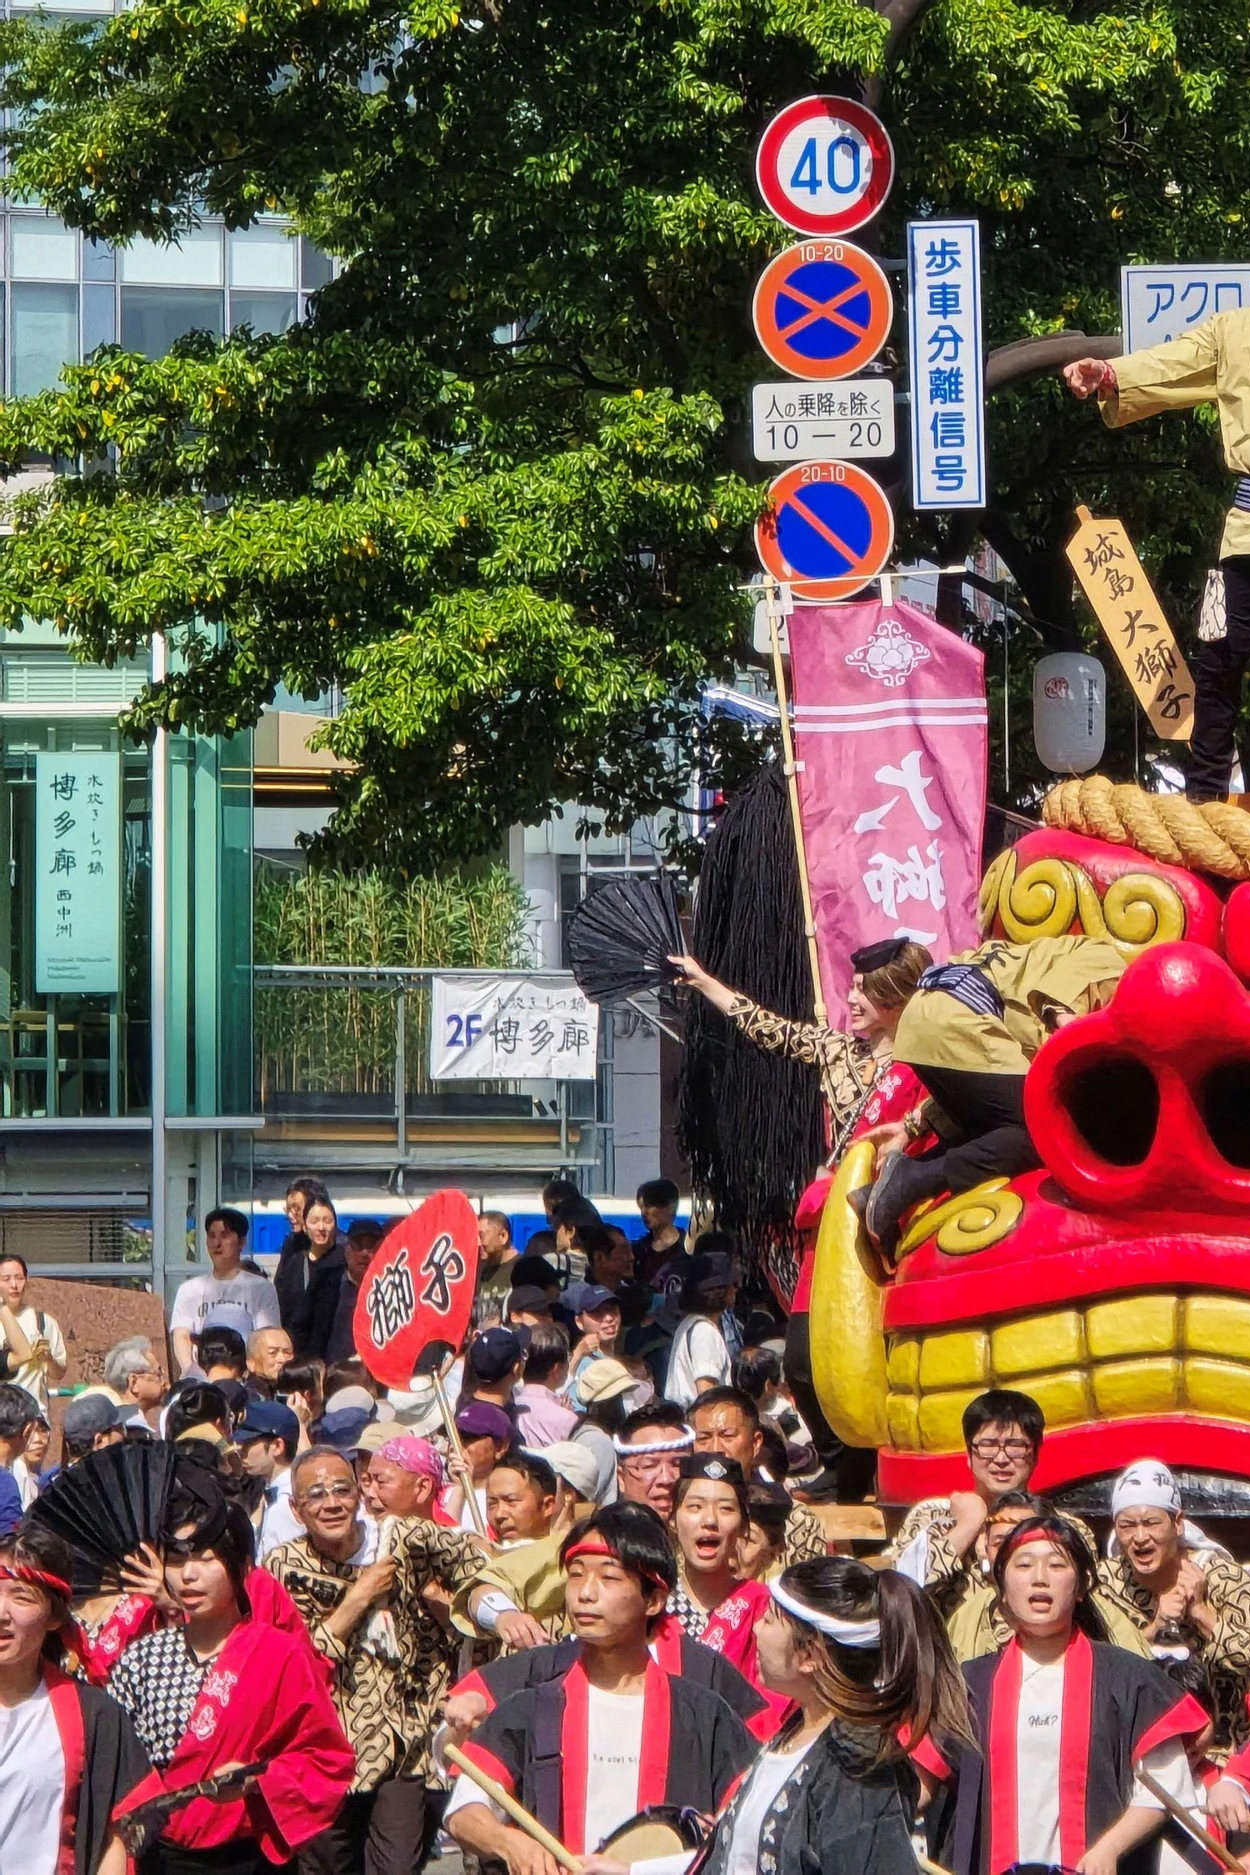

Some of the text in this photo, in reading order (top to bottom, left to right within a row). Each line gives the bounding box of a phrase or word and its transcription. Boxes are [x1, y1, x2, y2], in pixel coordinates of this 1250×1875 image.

[790, 136, 861, 195] 40
[800, 245, 844, 261] 10-20
[925, 238, 967, 491] 歩車分離信号
[765, 392, 880, 418] 人の乗降を除く
[801, 466, 845, 482] 20-10
[49, 773, 79, 876] 博多廊
[446, 1014, 590, 1056] 2F 博多廊
